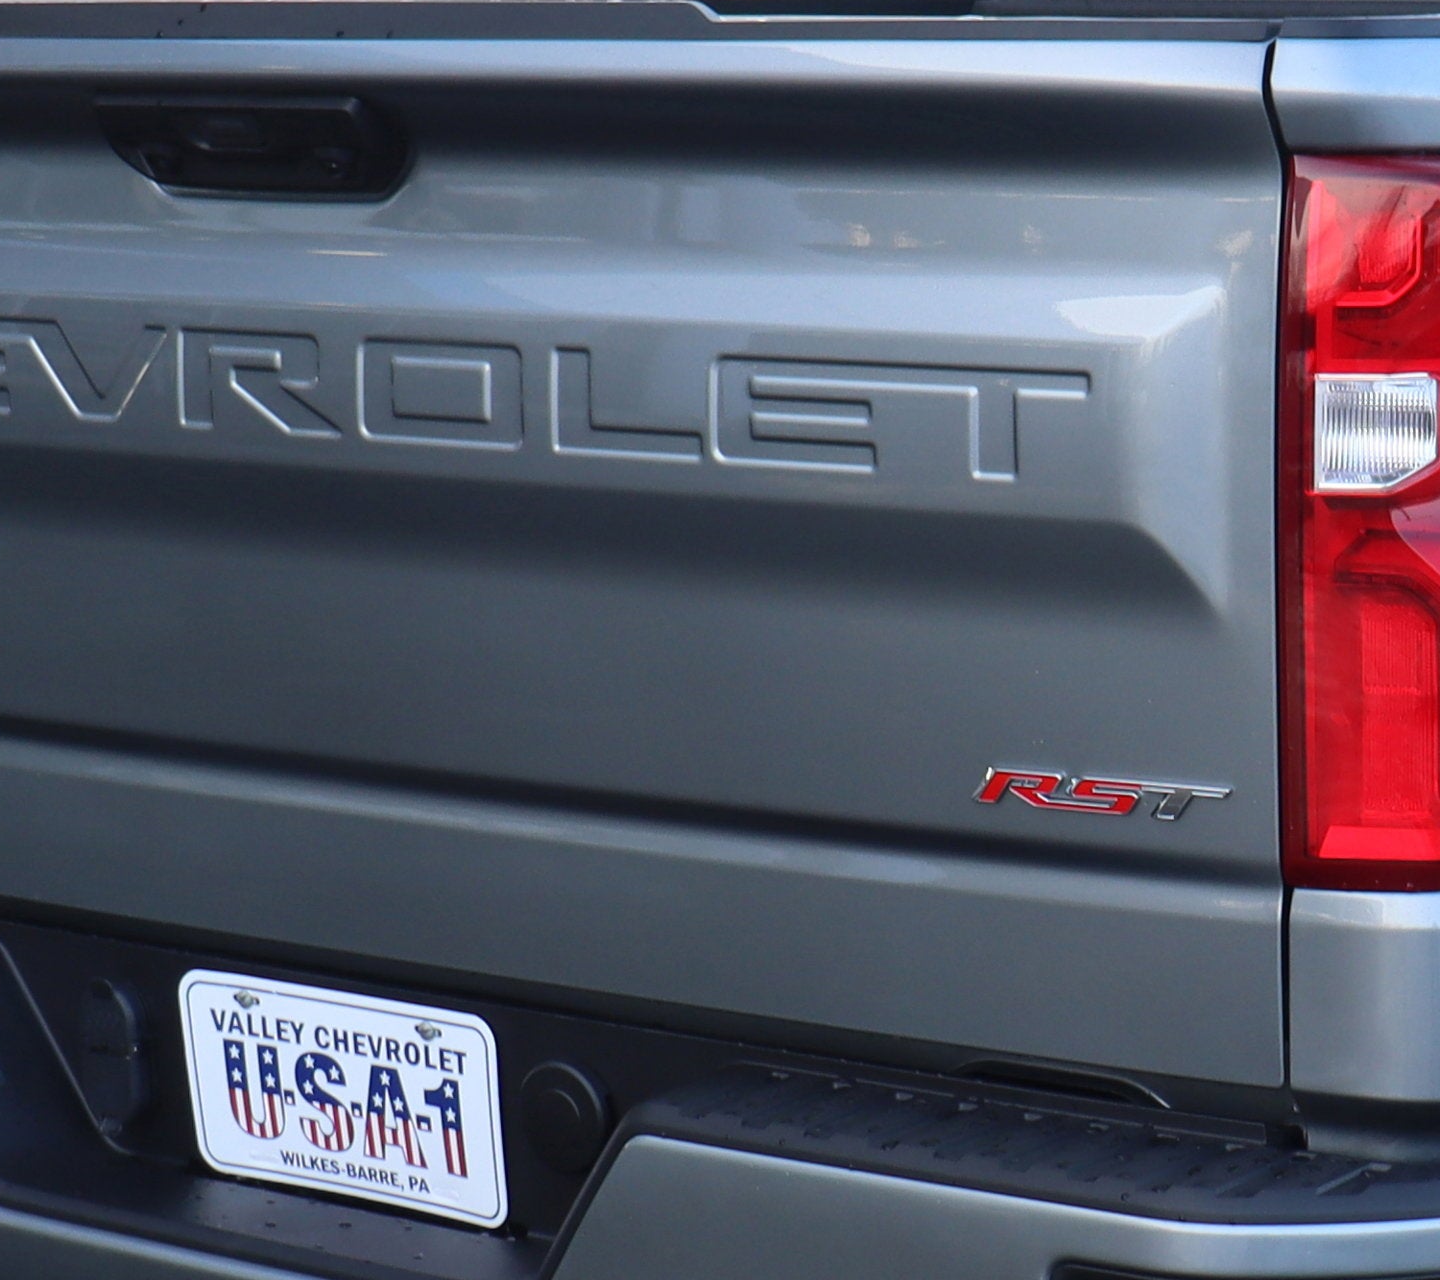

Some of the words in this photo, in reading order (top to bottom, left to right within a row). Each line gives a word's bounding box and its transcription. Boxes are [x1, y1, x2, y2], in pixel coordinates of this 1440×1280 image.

[972, 766, 1234, 820] RST
[210, 1008, 304, 1044] VALLEY
[314, 1026, 467, 1075] CHEVROLET
[280, 1150, 405, 1191] WILKES-BARRE,
[409, 1176, 431, 1194] PA
